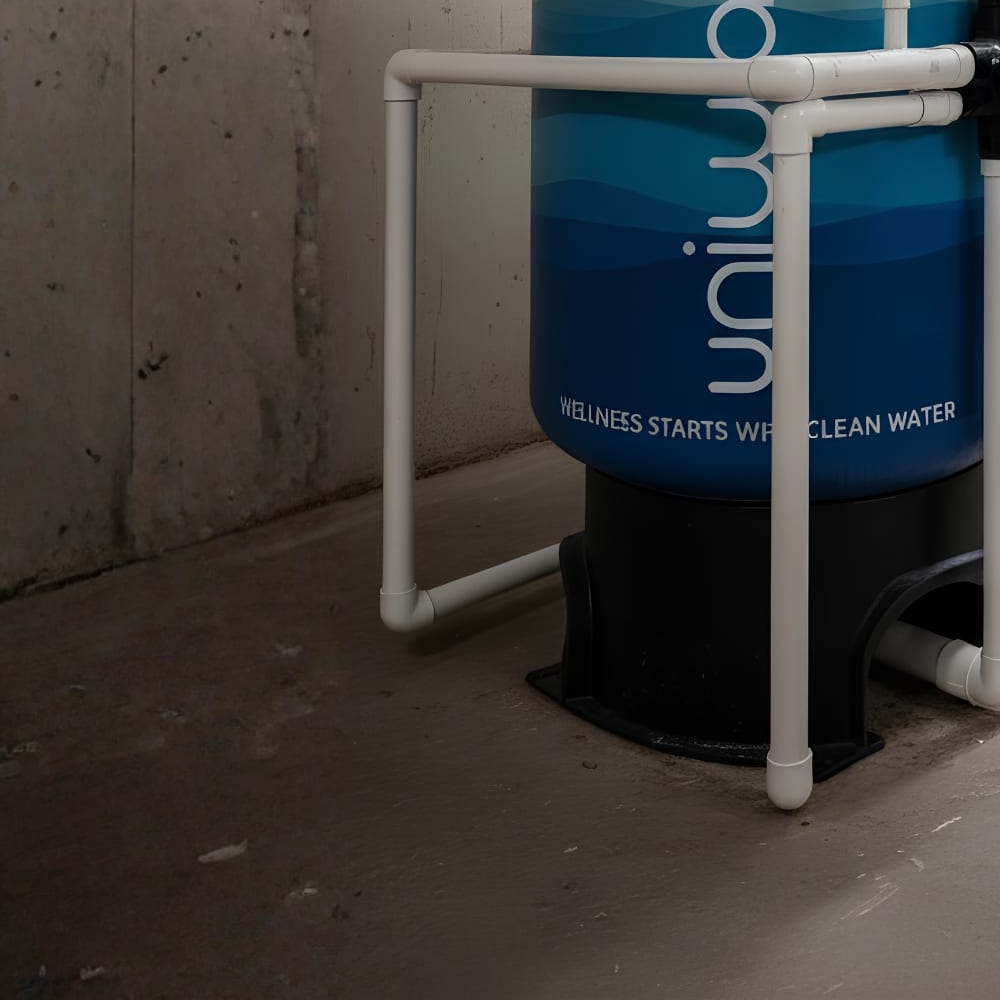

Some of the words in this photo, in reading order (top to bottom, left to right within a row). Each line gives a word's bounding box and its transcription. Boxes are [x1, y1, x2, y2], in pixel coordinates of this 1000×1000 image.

[647, 416, 729, 441] STARTS
[807, 413, 881, 439] CLEAN
[887, 400, 956, 433] WATER
